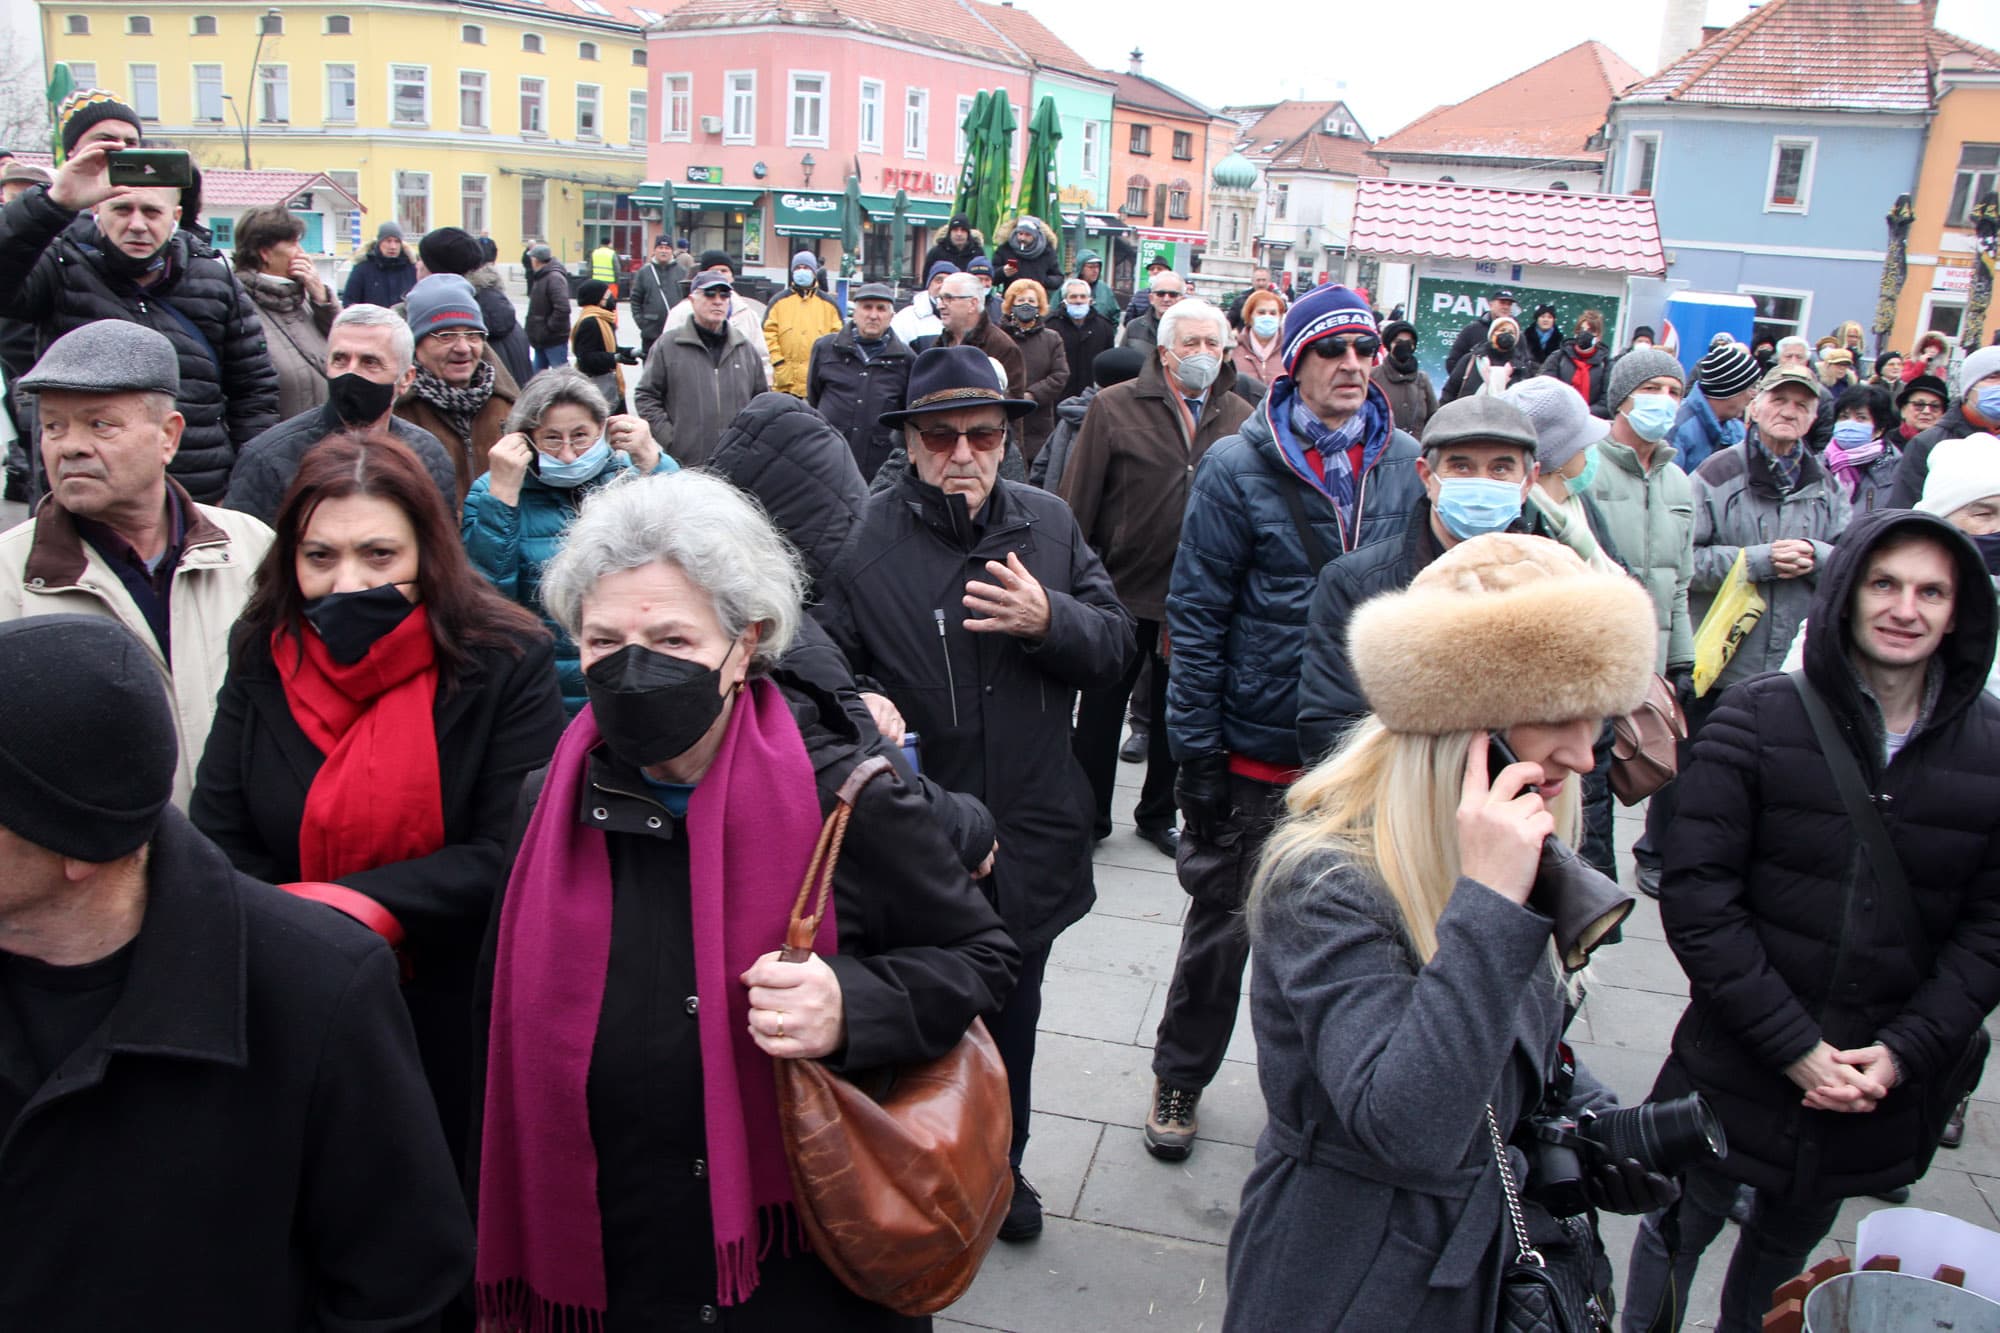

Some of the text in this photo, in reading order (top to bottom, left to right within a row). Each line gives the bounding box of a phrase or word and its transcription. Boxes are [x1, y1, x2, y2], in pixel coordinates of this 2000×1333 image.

[882, 166, 934, 192] PIZZA
[781, 194, 837, 212] Carlsberg
[1143, 241, 1165, 251] OPEN
